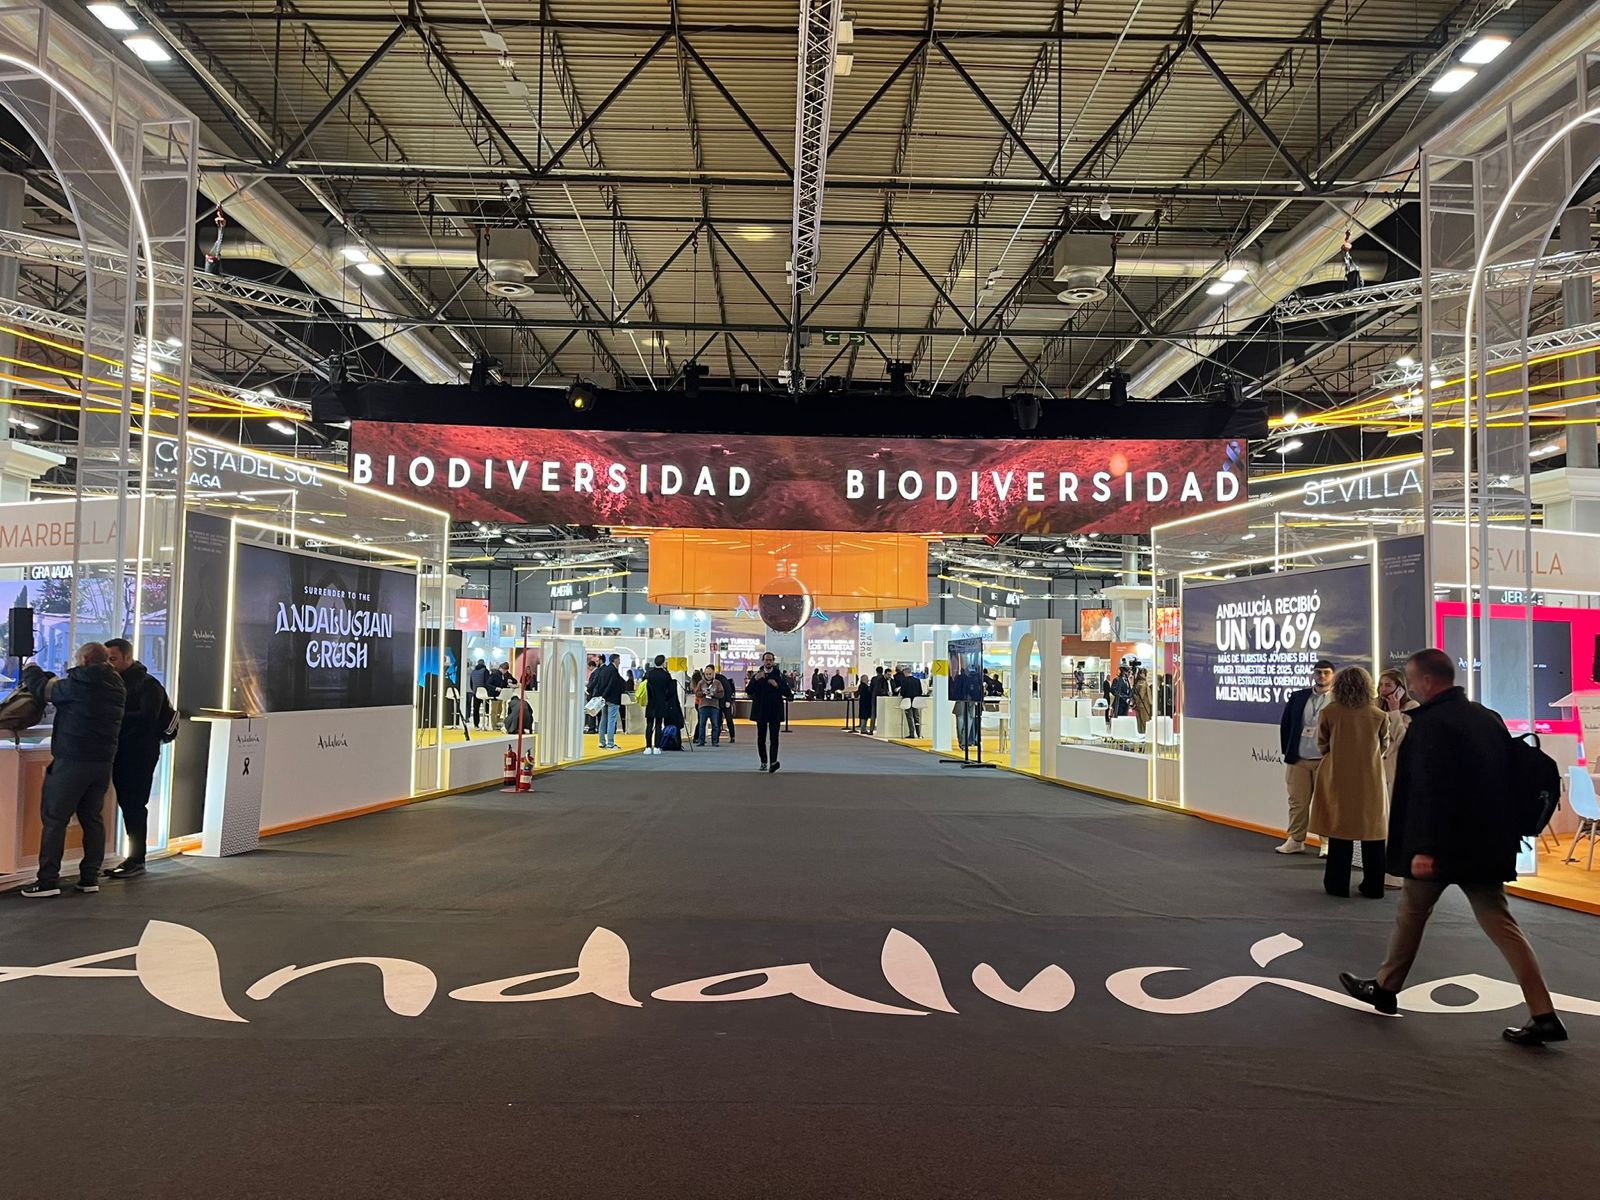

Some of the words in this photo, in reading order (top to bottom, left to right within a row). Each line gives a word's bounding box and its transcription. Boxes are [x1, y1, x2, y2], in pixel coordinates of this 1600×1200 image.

[240, 455, 281, 480] DEL
[284, 464, 323, 487] SOL
[353, 453, 751, 497] BIODIVERSIDAD
[846, 469, 1240, 502] BIODIVERSIDAD
[1303, 468, 1423, 506] SEVILLA
[304, 585, 345, 598] SURRENDER
[348, 591, 357, 600] TO
[359, 593, 371, 602] THE
[1216, 594, 1273, 619] ANDALUCÍA
[1275, 588, 1321, 614] RECIBIÓ
[275, 602, 393, 641] ANDALUSIAN
[1216, 618, 1247, 651] UN
[1253, 613, 1321, 653] 10,6%
[306, 640, 368, 669] CRUSH
[1213, 664, 1234, 675] PRIMER
[1235, 664, 1266, 675] TRIMESTRE
[1266, 664, 1276, 675] DE
[1294, 664, 1315, 675] GRAC
[1218, 651, 1231, 664] MÁS
[1231, 653, 1240, 663] DE
[1240, 653, 1267, 663] TURISTAS
[1268, 650, 1298, 663] JÓVENES
[1299, 652, 1309, 663] EN
[1309, 652, 1319, 663] EL
[1218, 675, 1225, 685] A
[1224, 675, 1237, 686] UNA
[1237, 675, 1273, 686] ESTRATEGIA
[1273, 675, 1311, 687] ORIENTADA
[1272, 687, 1281, 703] Y
